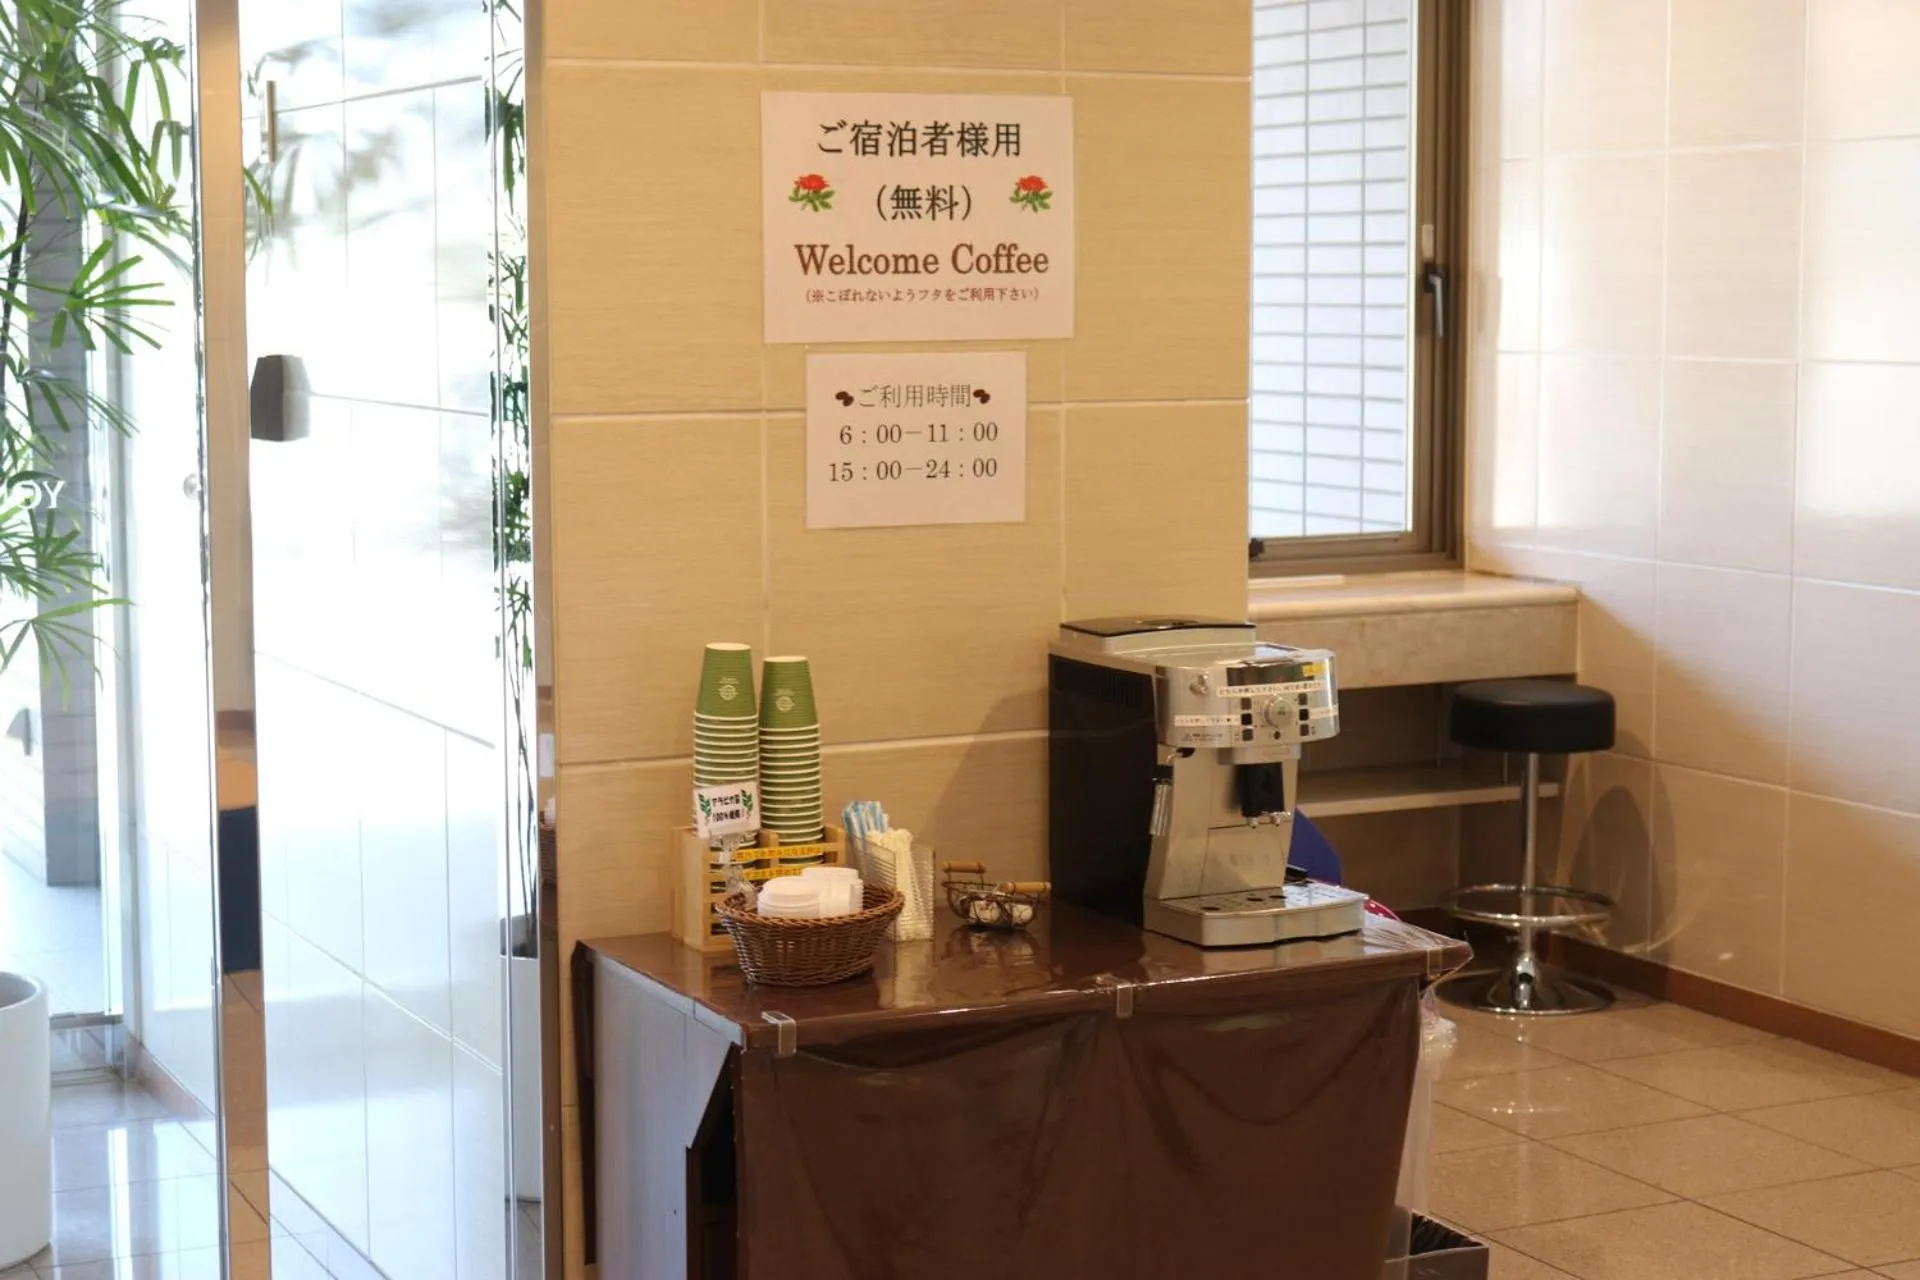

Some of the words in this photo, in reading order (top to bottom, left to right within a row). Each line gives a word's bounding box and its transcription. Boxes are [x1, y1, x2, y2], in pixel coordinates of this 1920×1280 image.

[818, 119, 1021, 157] ご宿泊者様用
[876, 184, 972, 220] （無料）
[794, 244, 940, 275] Welcome
[951, 243, 1049, 274] Coffee
[858, 383, 971, 409] ご利用時間
